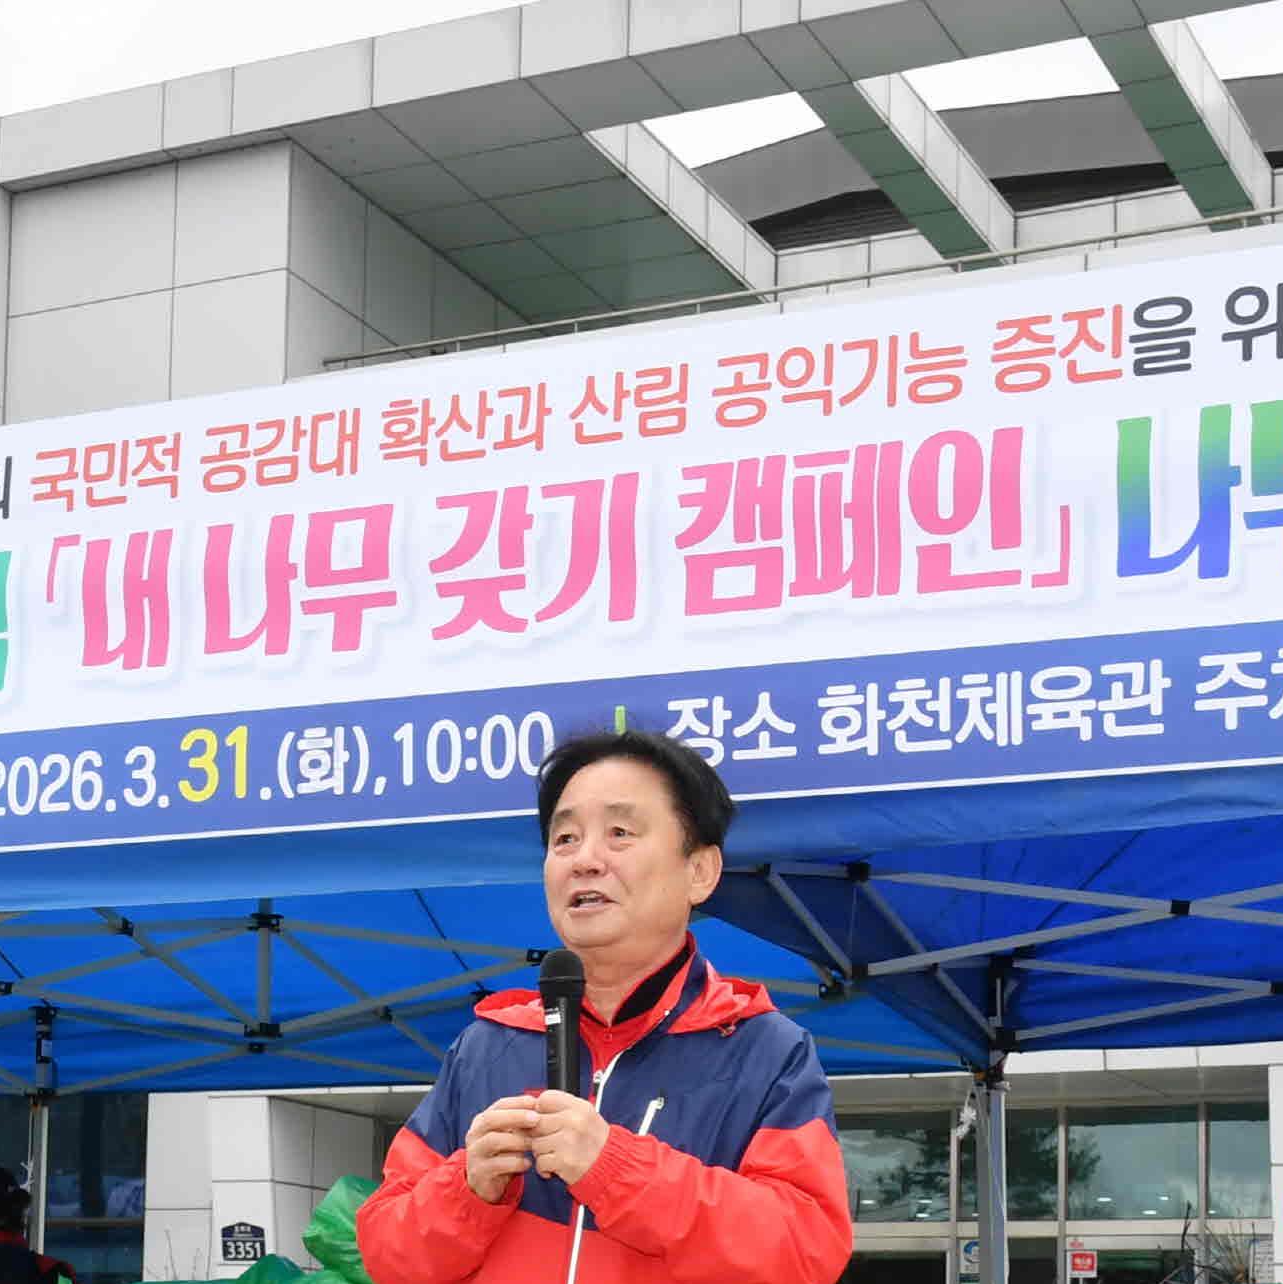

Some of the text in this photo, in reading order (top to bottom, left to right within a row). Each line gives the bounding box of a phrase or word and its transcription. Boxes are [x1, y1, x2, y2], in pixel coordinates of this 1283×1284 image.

[32, 433, 181, 512] 국민적
[201, 409, 361, 493] 공감대
[379, 383, 552, 466] 확산과
[571, 363, 688, 445] 산림
[712, 332, 967, 428] 공익기능
[992, 296, 1197, 393] 증진을
[203, 504, 397, 656] 나무
[428, 472, 639, 640] 갖기
[674, 426, 1070, 617] 캠페인」
[666, 692, 798, 768] 장소
[817, 659, 1173, 756] 화천체육관
[226, 1241, 261, 1259] 3351
